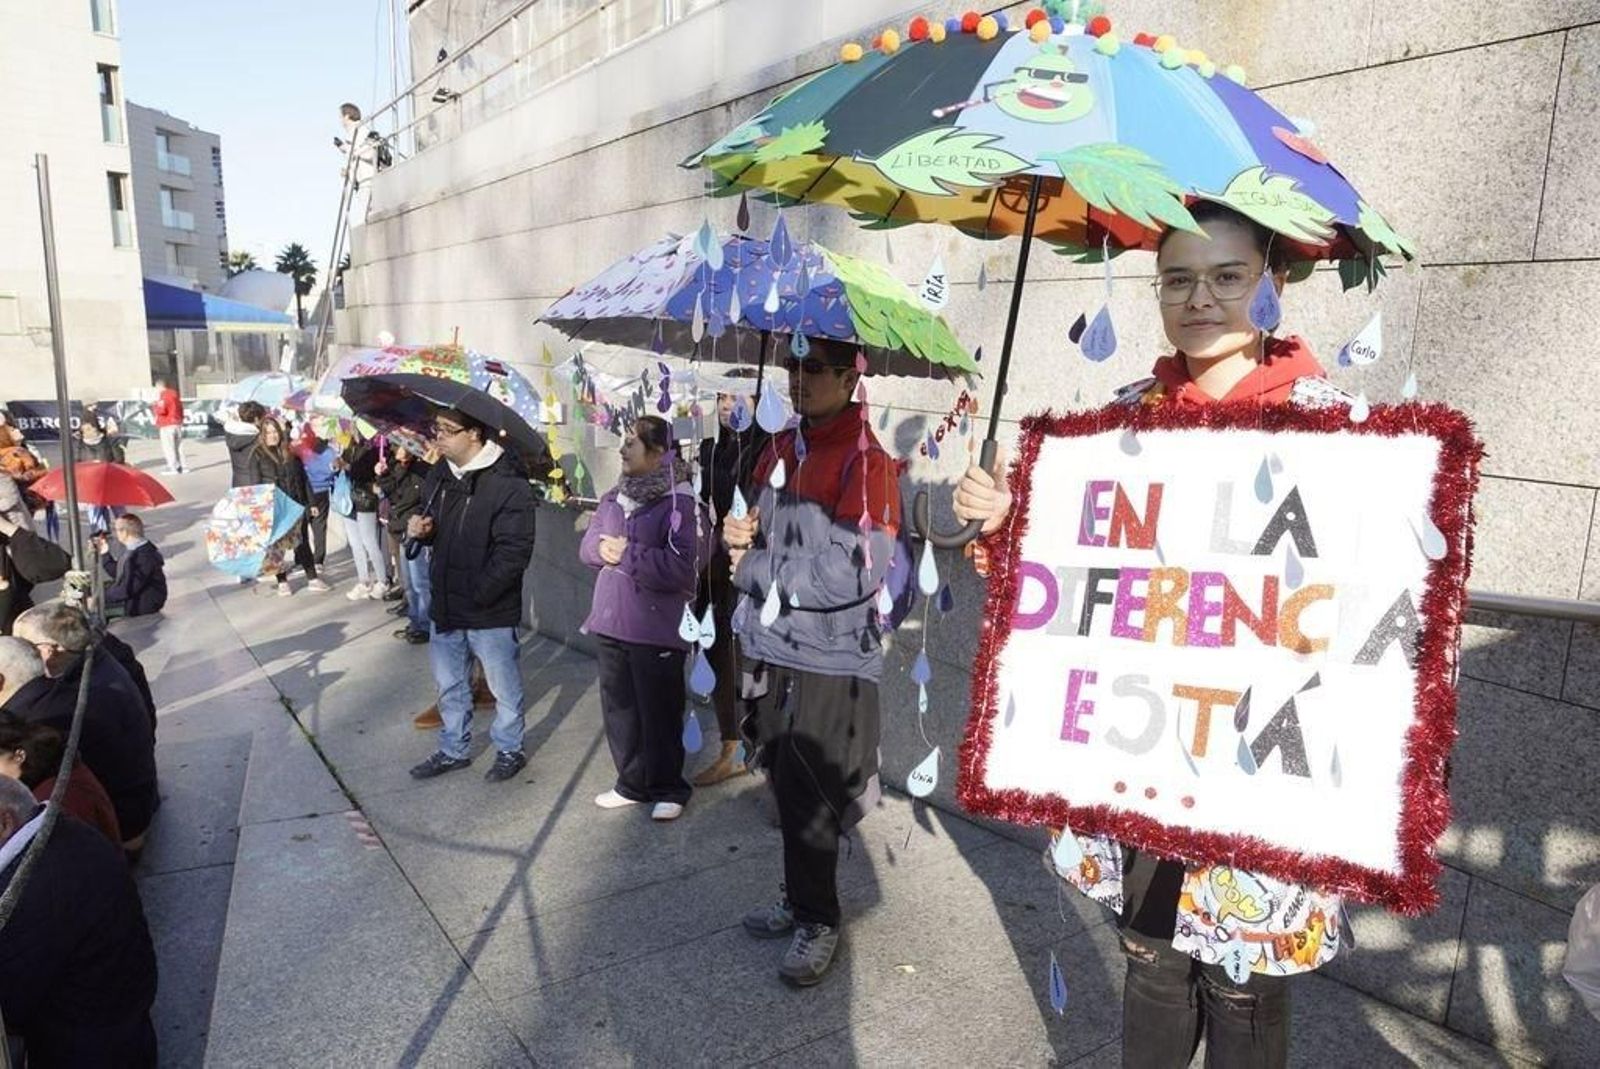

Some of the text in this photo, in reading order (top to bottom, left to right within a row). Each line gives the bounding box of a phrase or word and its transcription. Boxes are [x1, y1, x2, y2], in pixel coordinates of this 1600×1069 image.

[1077, 480, 1319, 559] EN LA
[1060, 669, 1322, 779] ESTÁ
